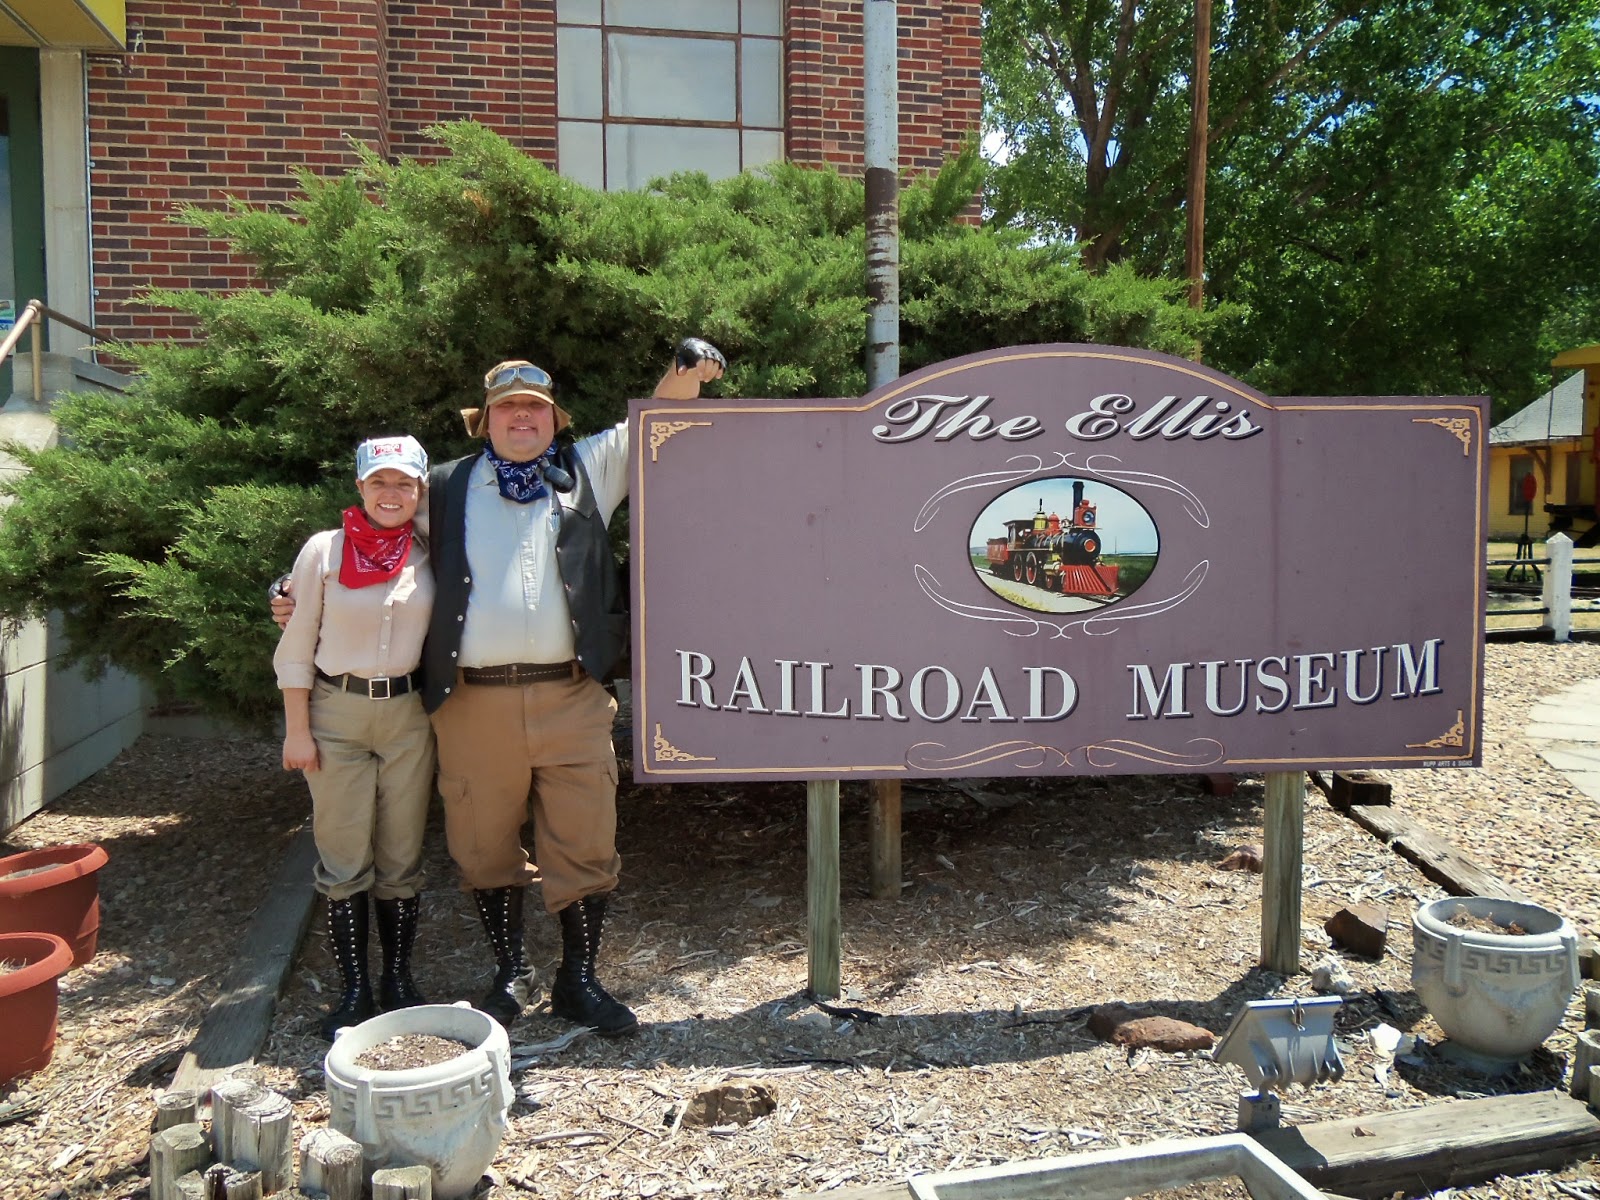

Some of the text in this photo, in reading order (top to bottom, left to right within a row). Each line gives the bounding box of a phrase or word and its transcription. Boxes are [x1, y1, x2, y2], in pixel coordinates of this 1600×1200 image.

[872, 393, 1263, 443] The Ellis
[675, 638, 1444, 723] RAILROAD MUSEUM
